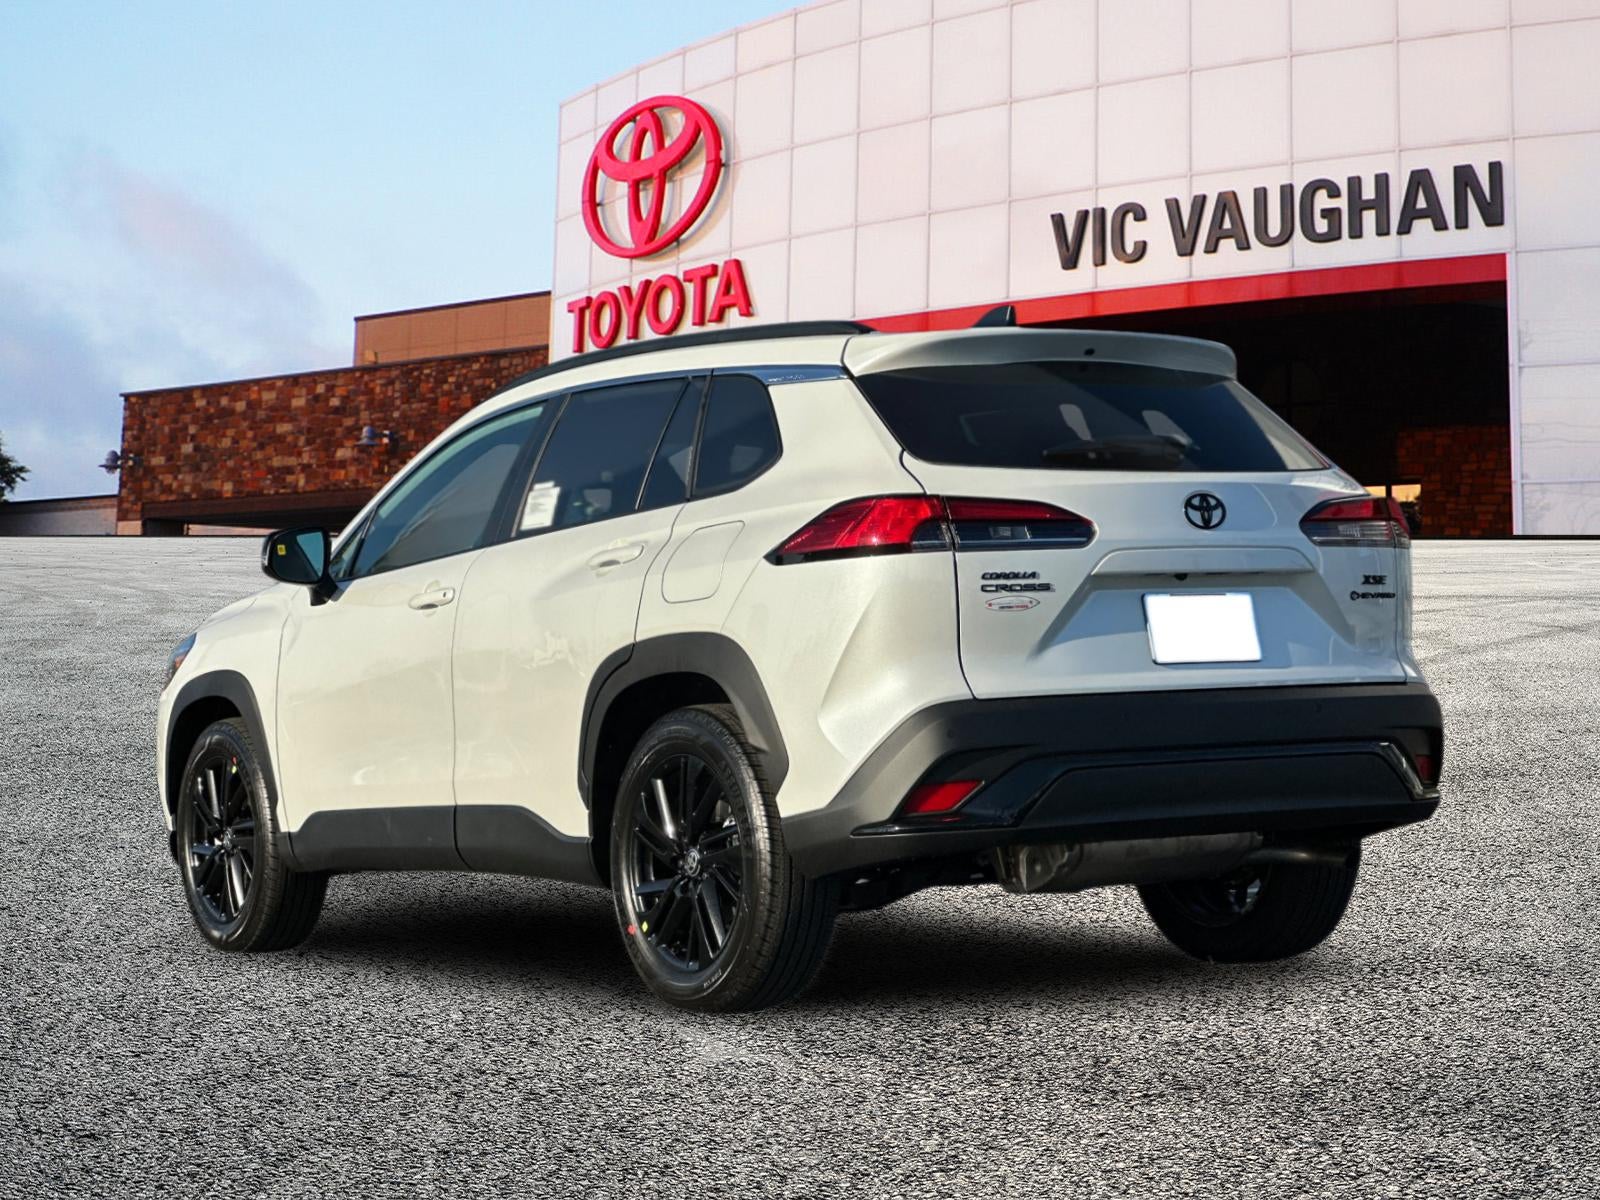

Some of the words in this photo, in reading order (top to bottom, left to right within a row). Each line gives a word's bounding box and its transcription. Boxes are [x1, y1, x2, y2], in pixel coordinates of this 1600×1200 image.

[1050, 201, 1148, 271] VIC
[1165, 160, 1505, 257] VAUGHAN
[567, 258, 755, 353] TOYOTA
[981, 571, 1039, 580] COROLLA
[1361, 574, 1387, 585] XSE
[981, 583, 1054, 592] CROSS
